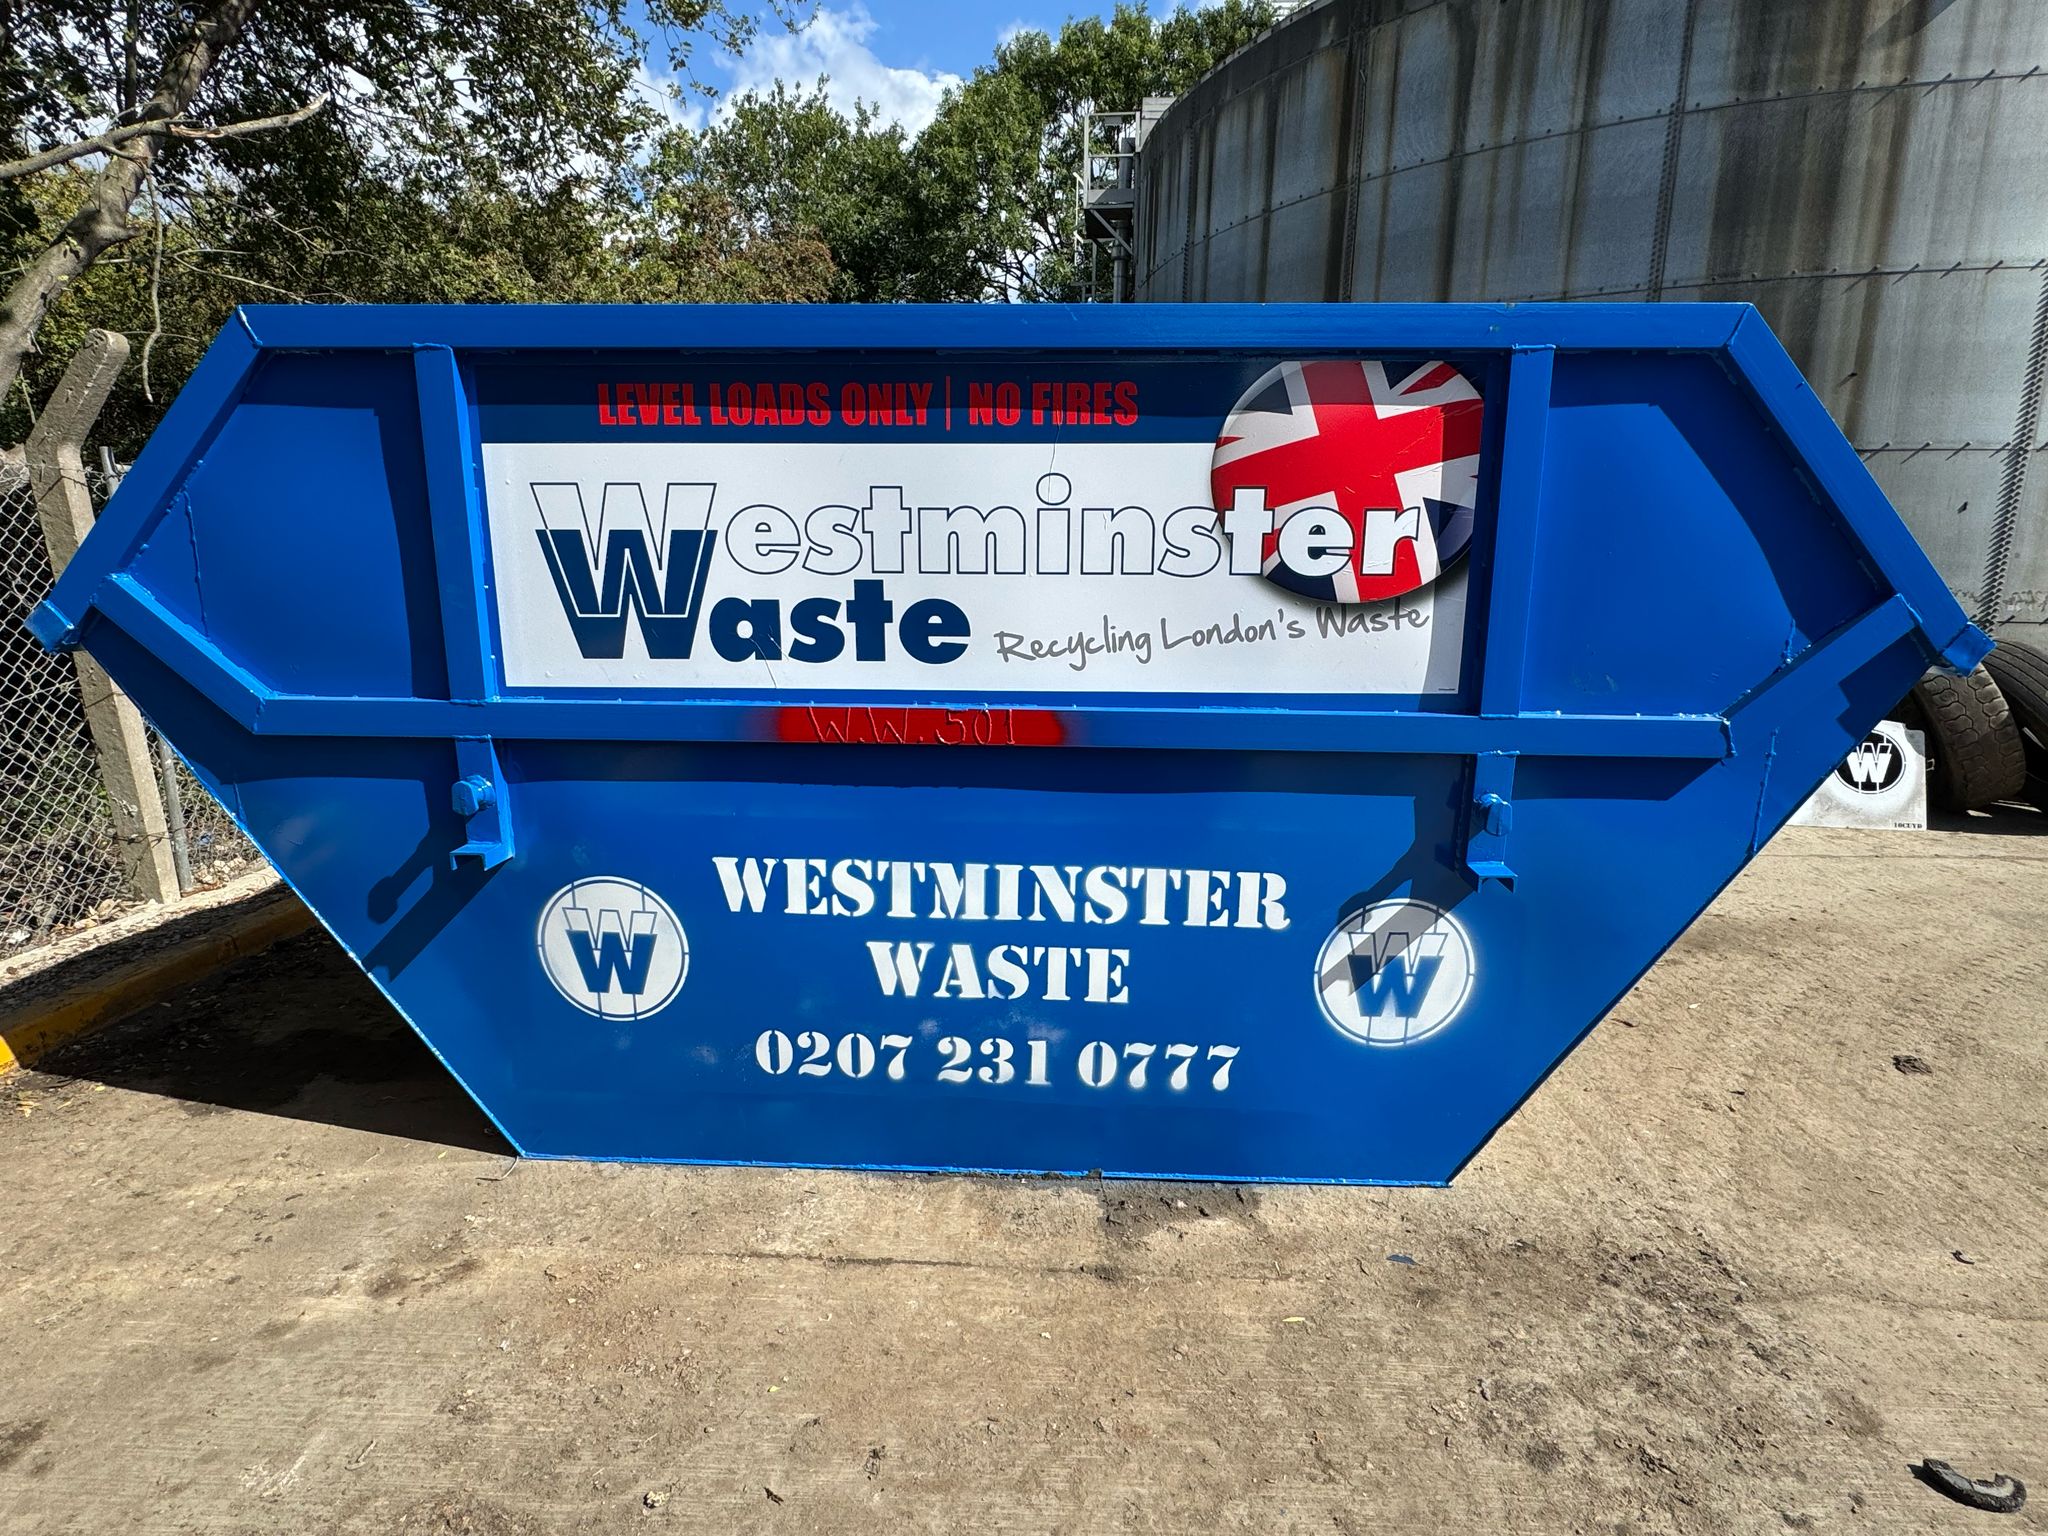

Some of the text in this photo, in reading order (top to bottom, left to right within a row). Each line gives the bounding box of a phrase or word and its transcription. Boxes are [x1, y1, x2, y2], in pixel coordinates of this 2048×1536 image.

[598, 381, 1139, 426] LEVEL LOADS ONLY NO FIRES
[529, 472, 1421, 617] Westminster
[535, 530, 972, 665] Waste
[993, 601, 1430, 671] Recycling London's Waste
[711, 856, 1291, 931] WESTMINSTER
[866, 941, 1131, 1003] WASTE
[755, 1029, 1241, 1092] 0207 231 0777
